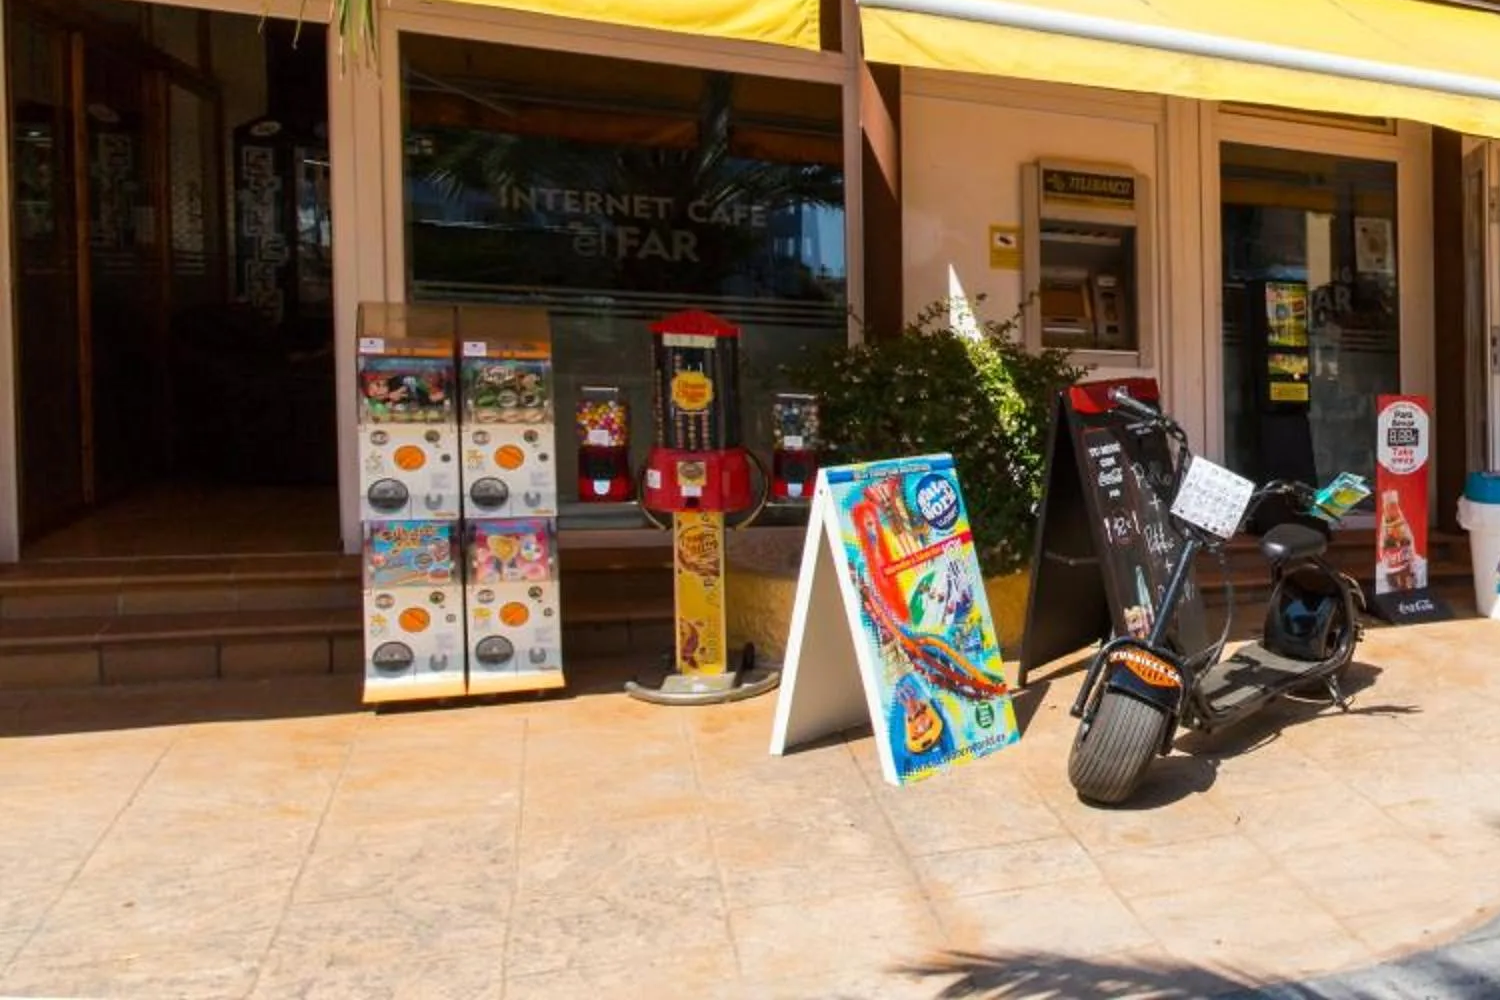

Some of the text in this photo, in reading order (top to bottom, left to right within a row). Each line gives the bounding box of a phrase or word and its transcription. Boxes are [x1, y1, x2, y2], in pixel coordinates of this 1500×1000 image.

[499, 184, 675, 221] INTERNET
[572, 226, 700, 263] el FAR
[1392, 447, 1414, 456] Take
